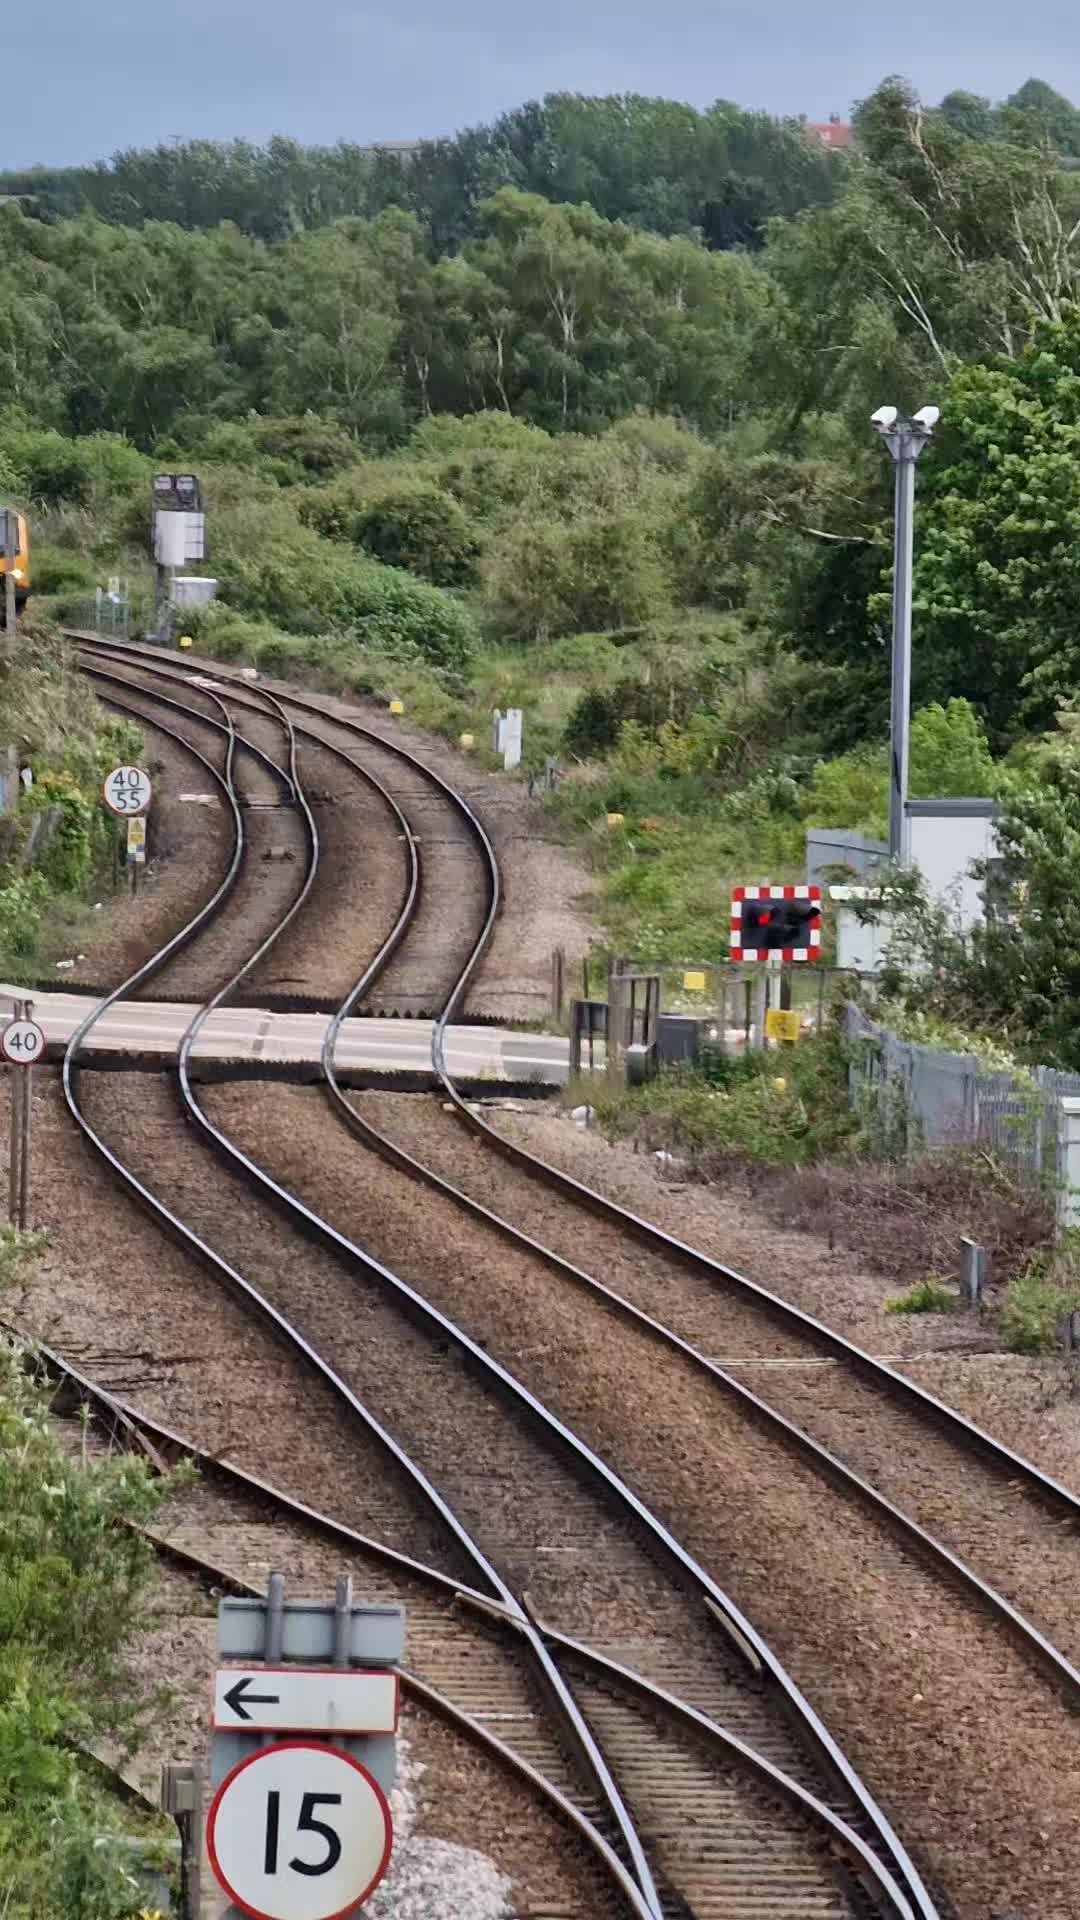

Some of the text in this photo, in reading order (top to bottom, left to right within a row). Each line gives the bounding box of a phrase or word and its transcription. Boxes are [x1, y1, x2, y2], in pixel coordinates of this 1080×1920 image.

[113, 770, 140, 788] 40
[117, 791, 141, 809] 55
[10, 1032, 37, 1051] 40
[264, 1791, 342, 1876] 15
